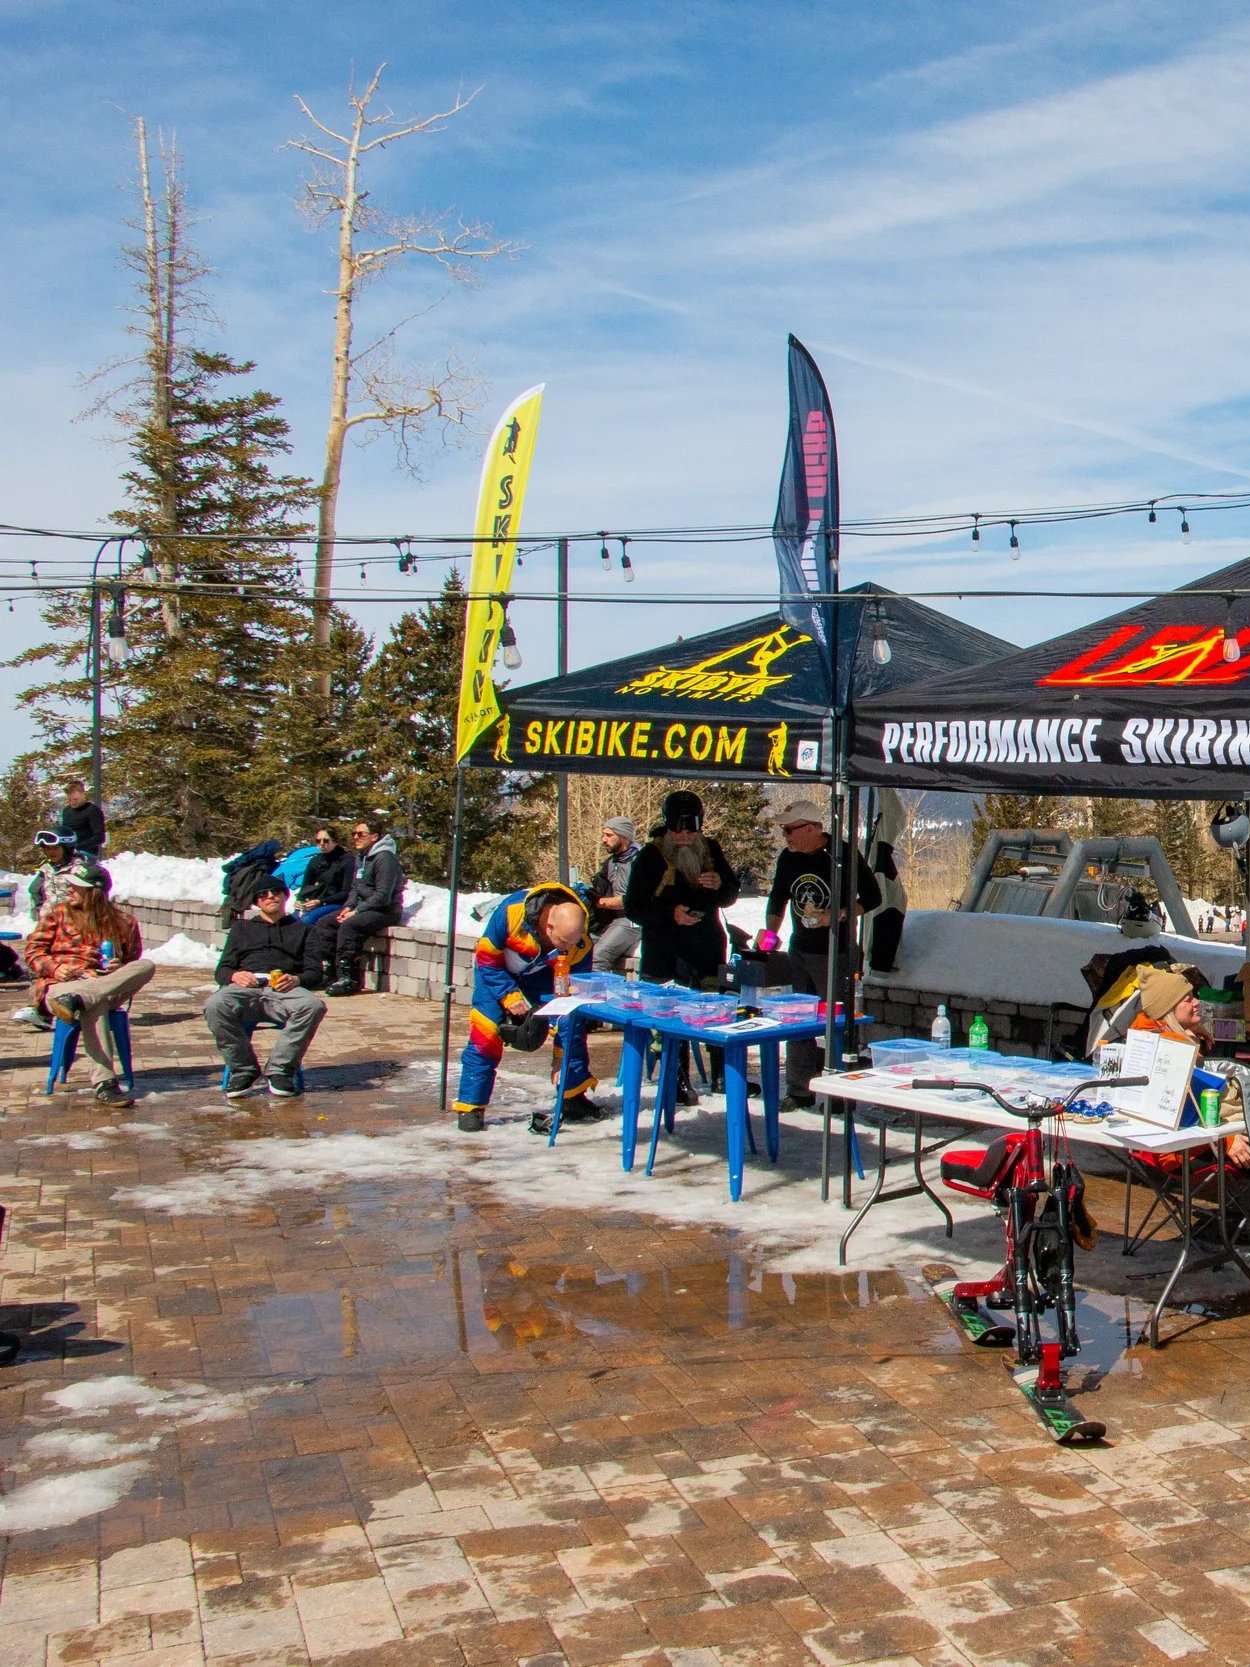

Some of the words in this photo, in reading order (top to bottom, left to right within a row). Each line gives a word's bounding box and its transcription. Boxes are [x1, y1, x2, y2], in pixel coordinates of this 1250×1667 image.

[614, 685, 652, 695] NO
[661, 688, 757, 703] LIMITS
[629, 671, 786, 696] SKIBYK
[523, 720, 748, 764] SKIBIKE.COM
[881, 718, 1102, 764] PERFORMANCE
